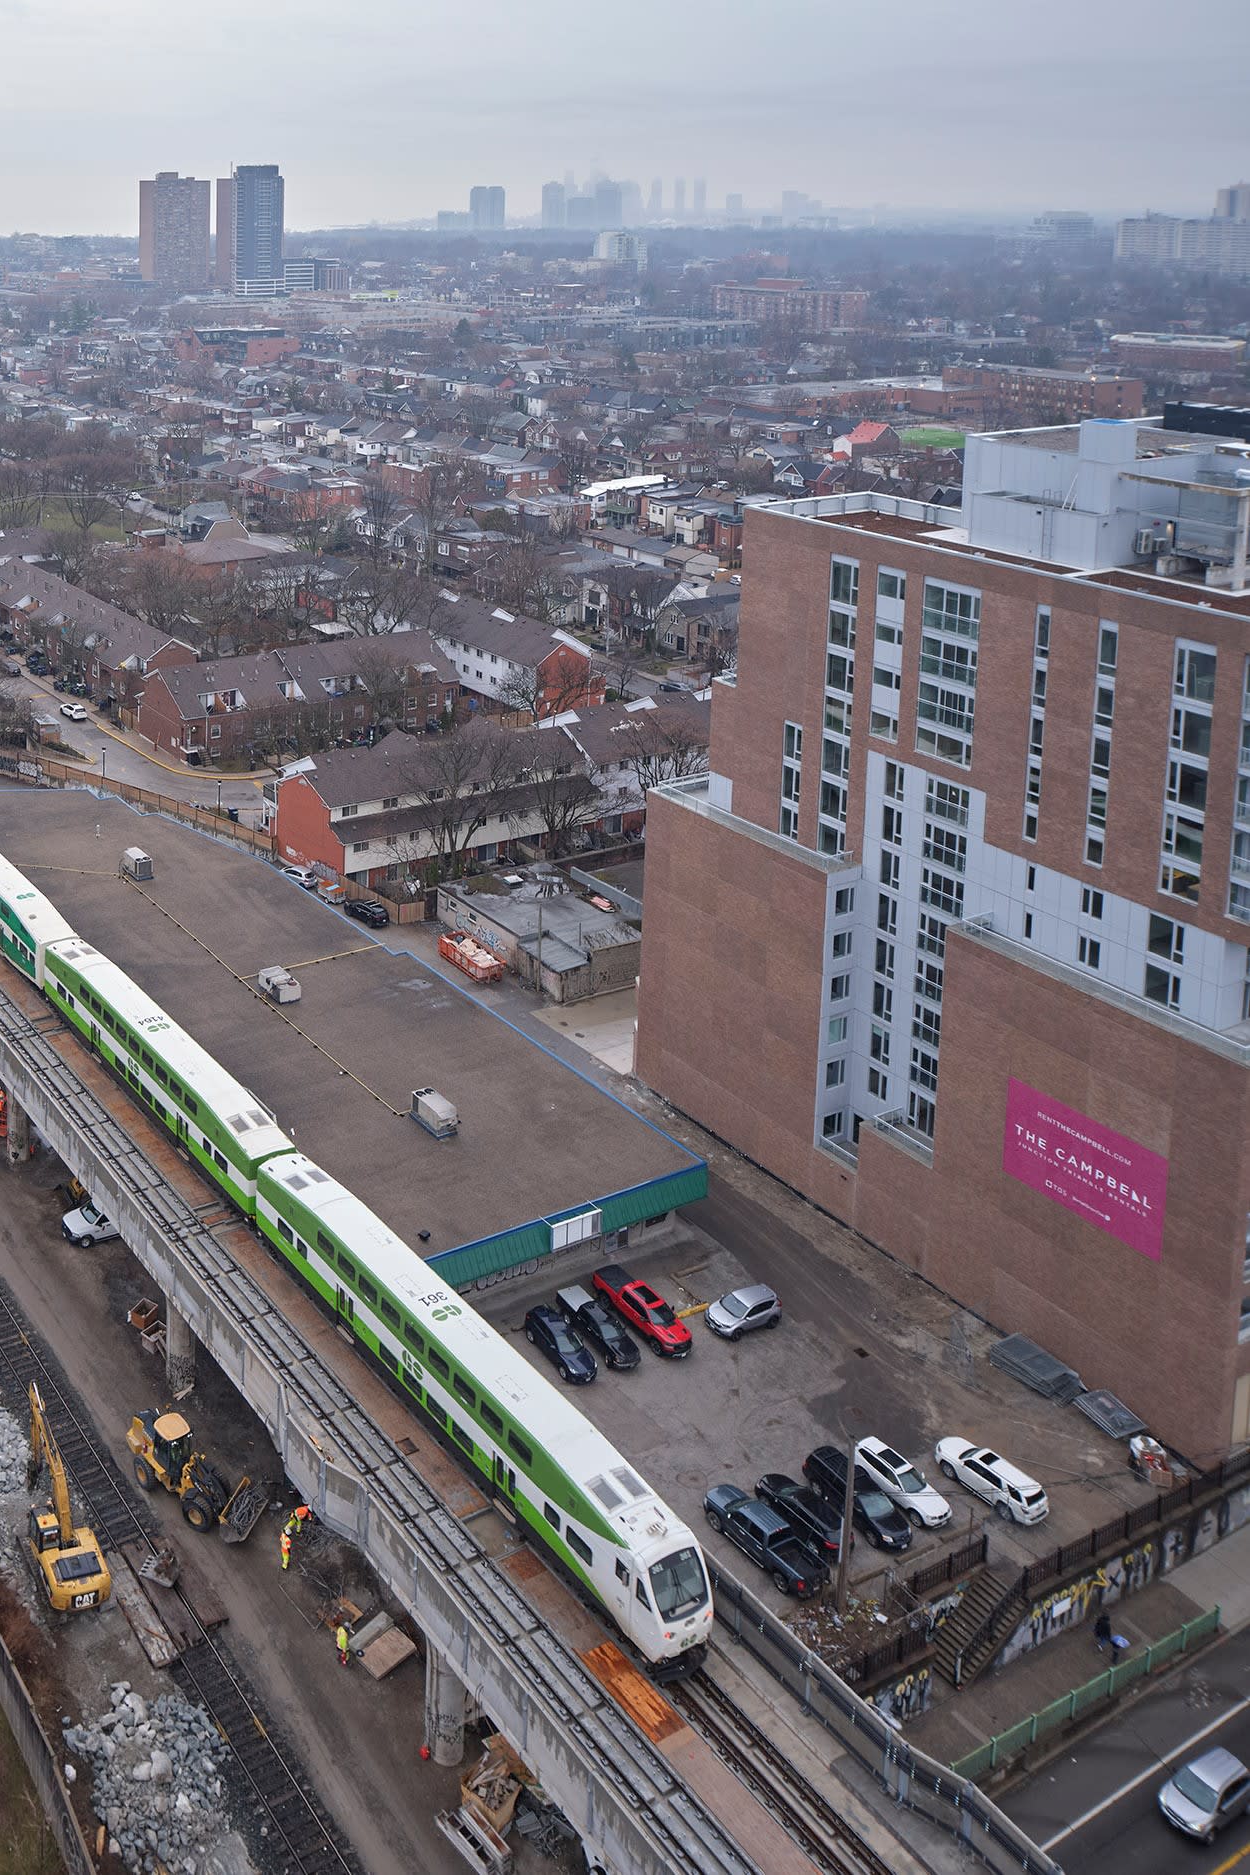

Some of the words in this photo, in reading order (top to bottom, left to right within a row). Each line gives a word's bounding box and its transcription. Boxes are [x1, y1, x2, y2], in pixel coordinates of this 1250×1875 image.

[1014, 1123, 1048, 1151] THE
[1054, 1147, 1153, 1210] CAMPBELL
[1037, 1111, 1132, 1167] RENTTHECAMPBELL.COM
[1017, 1141, 1059, 1168] JUNCTION
[1062, 1165, 1105, 1194] TRIANGLE
[1107, 1192, 1148, 1218] RENTALS
[417, 1290, 449, 1307] 361
[75, 1591, 96, 1609] CAT
